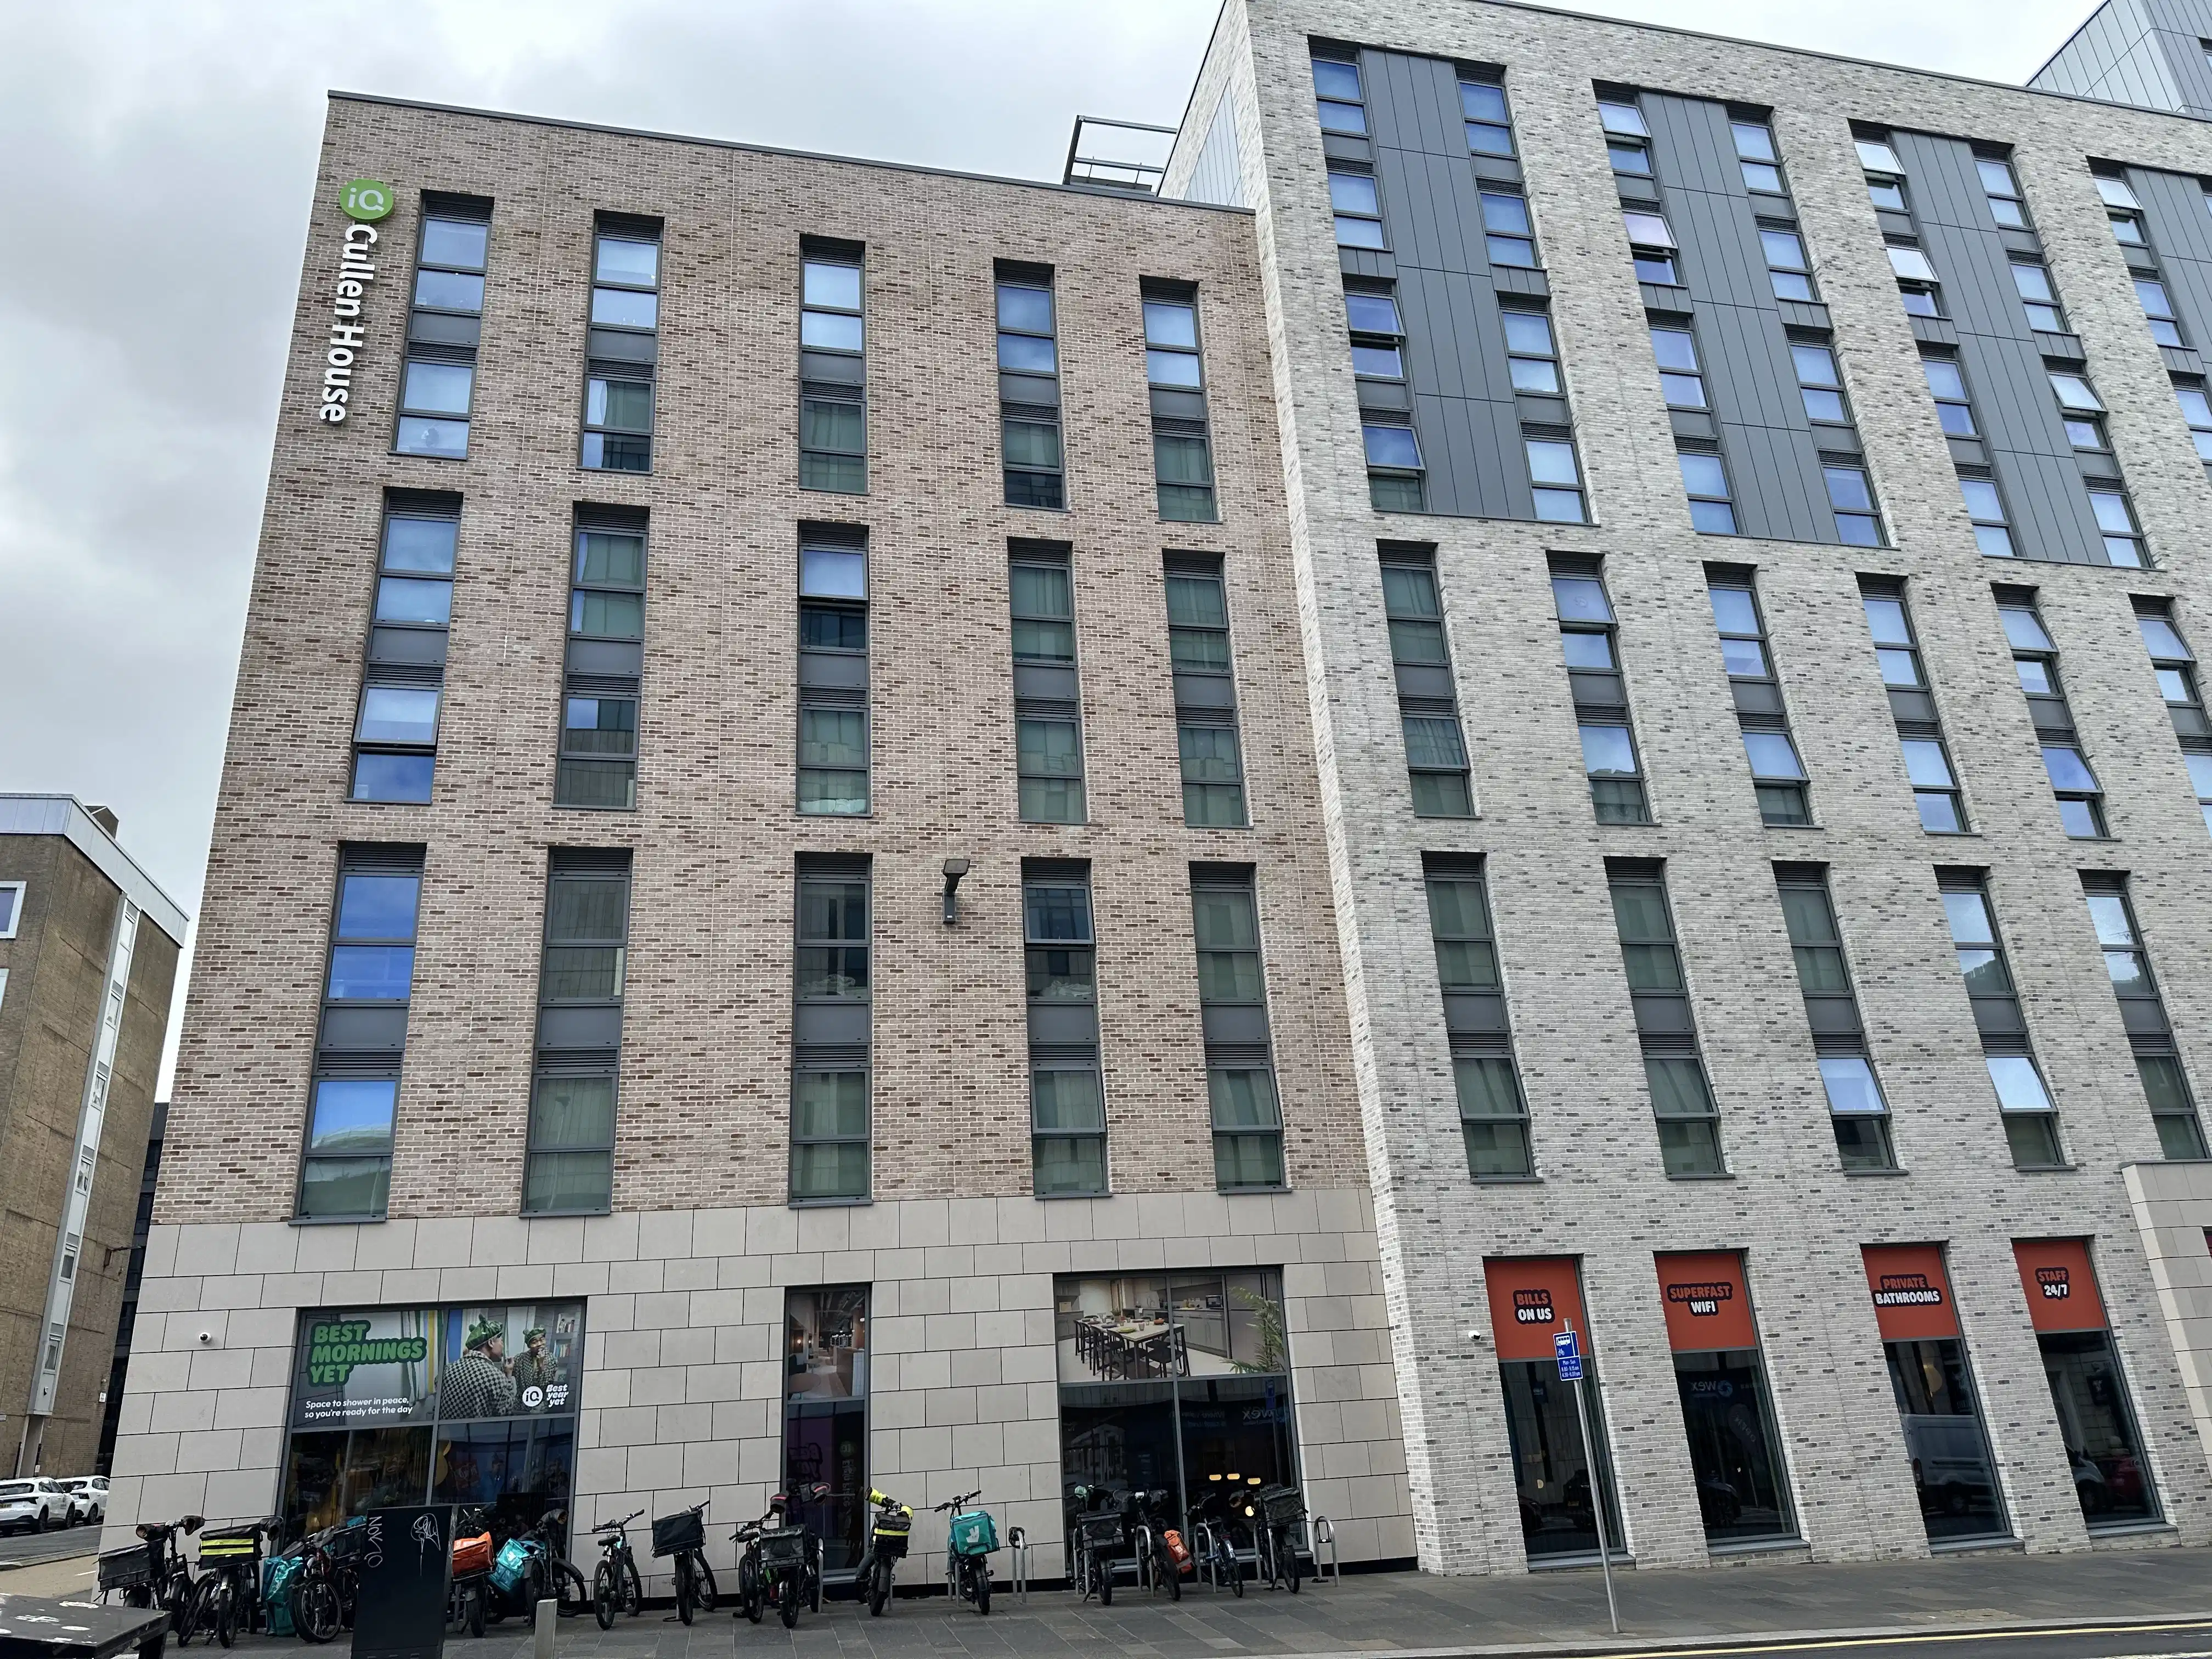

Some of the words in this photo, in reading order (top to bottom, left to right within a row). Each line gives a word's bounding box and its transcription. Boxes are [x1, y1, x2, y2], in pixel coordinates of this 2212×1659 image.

[348, 187, 384, 212] iQ
[334, 224, 378, 318] Cullen
[319, 324, 365, 423] House
[2038, 1270, 2066, 1282] STAFF
[1882, 1277, 1926, 1289] PRIVATE
[1669, 1285, 1730, 1299] SUPERFAST
[2044, 1284, 2067, 1296] 24/7
[1516, 1293, 1548, 1305] BILLS
[1875, 1291, 1940, 1304] BATHROOMS
[1691, 1301, 1716, 1313] WIFI
[1518, 1308, 1535, 1321] ON
[1536, 1308, 1552, 1320] US
[314, 1324, 366, 1343] BEST
[311, 1341, 422, 1363] MORNINGS
[310, 1364, 349, 1383] YET
[546, 1384, 568, 1392] Best
[526, 1391, 539, 1402] iQ
[546, 1391, 569, 1401] year
[306, 1400, 331, 1409] Space
[343, 1398, 372, 1407] shower
[382, 1397, 409, 1406] peace,
[549, 1398, 565, 1408] yet
[315, 1409, 341, 1419] you're
[342, 1408, 367, 1417] ready
[368, 1407, 380, 1415] for
[397, 1406, 413, 1414] day
